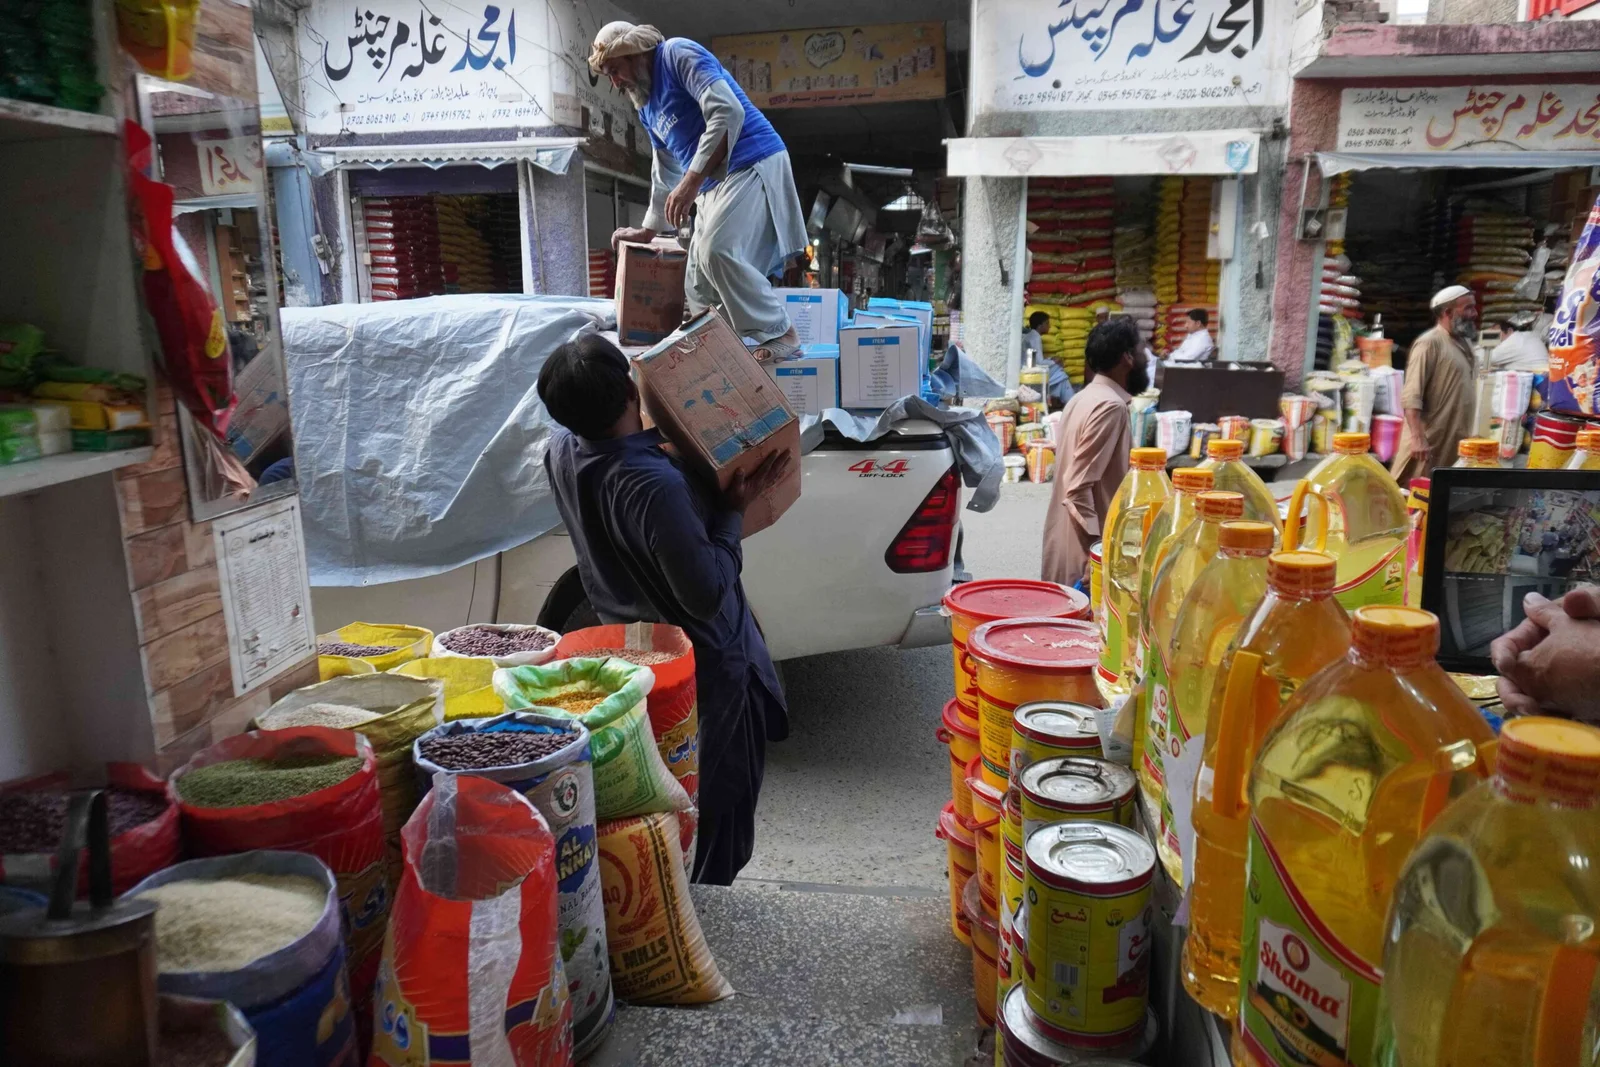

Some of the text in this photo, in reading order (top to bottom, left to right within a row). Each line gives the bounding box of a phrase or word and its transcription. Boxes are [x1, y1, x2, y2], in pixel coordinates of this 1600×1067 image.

[450, 5, 516, 71] امجد
[561, 836, 582, 857] AL
[622, 935, 669, 969] MILLS
[1260, 941, 1342, 1019] Shama
